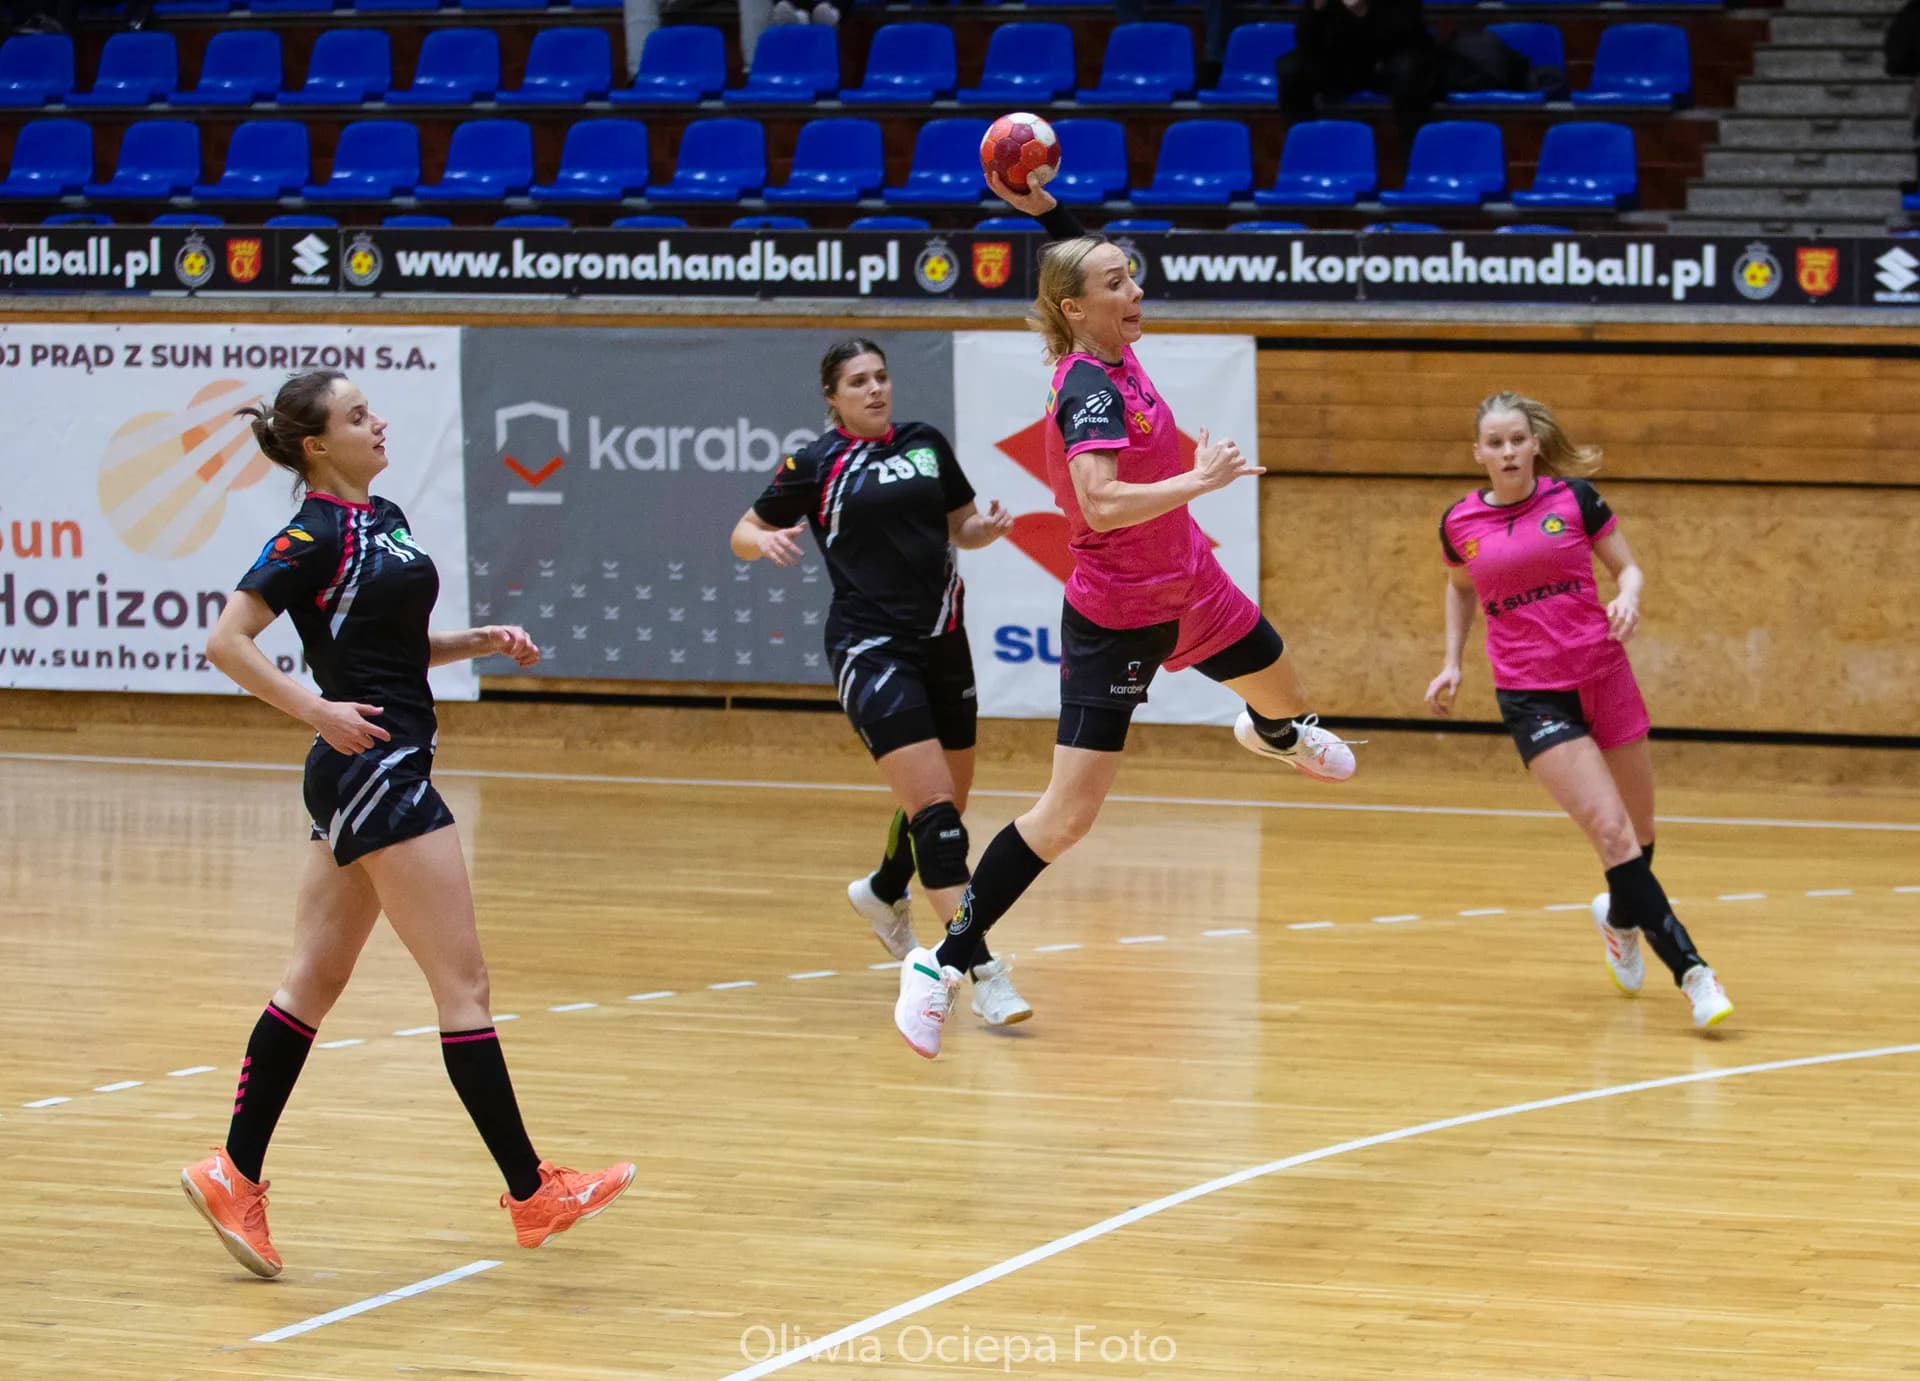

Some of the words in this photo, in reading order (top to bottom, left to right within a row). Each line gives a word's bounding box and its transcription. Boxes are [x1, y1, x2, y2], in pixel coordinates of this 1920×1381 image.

[396, 239, 899, 294] www.koronahandball.pl
[1161, 241, 1715, 299] www.koronahandball.pl
[31, 344, 114, 374] PRĄD
[124, 345, 142, 367] Z
[151, 345, 212, 368] SUN
[223, 345, 364, 369] HORIZON
[375, 347, 437, 370] S.A.
[589, 415, 835, 472] karabe
[0, 518, 83, 559] un
